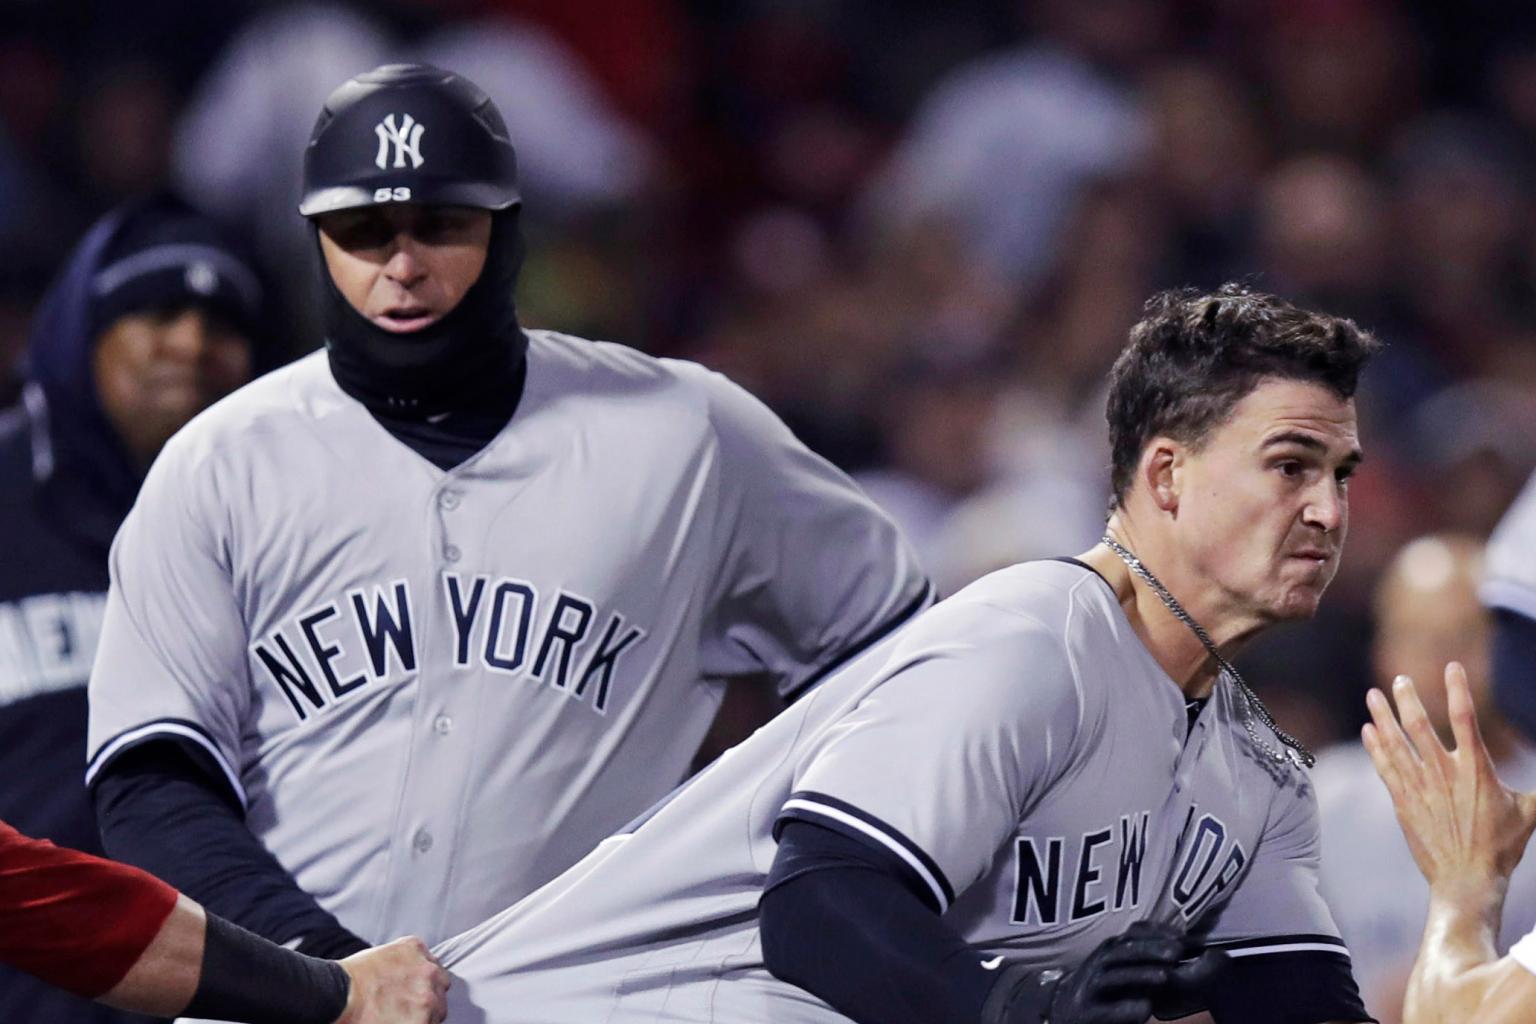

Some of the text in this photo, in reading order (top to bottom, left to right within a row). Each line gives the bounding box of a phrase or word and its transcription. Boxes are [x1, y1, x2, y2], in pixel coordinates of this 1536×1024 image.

[375, 113, 425, 170] NY
[373, 187, 411, 203] 53
[249, 571, 647, 722] NEW YORK
[1010, 811, 1150, 926] NEW
